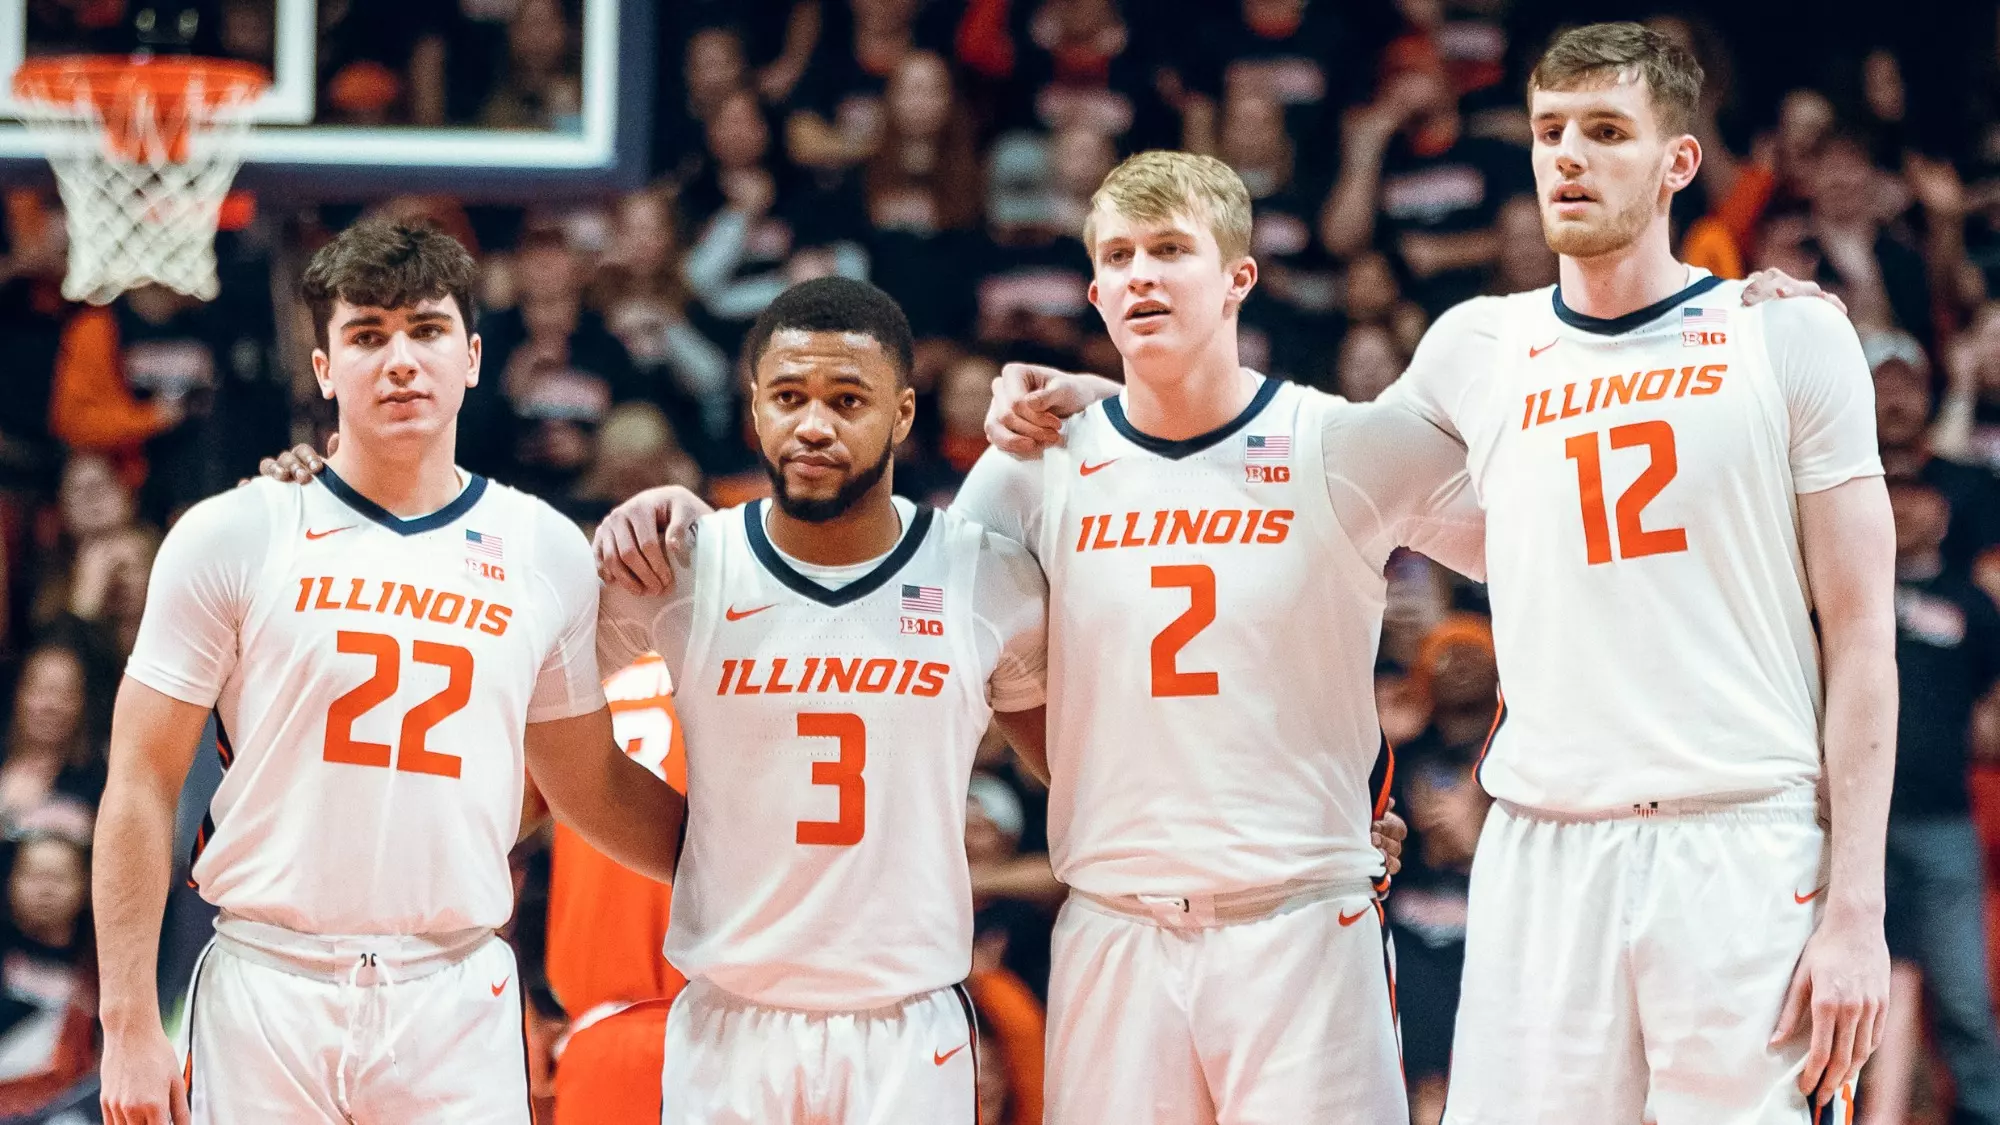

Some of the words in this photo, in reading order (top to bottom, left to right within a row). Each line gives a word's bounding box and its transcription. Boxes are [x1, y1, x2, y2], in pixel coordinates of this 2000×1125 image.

[1521, 364, 1727, 430] ILLINOIS
[1076, 509, 1295, 552] ILLINOIS
[1565, 420, 1688, 565] 12
[294, 577, 513, 637] ILLINOIS
[1150, 564, 1219, 698] 2
[322, 630, 474, 779] 22
[717, 658, 950, 697] ILLINOIS
[795, 712, 866, 845] 3
